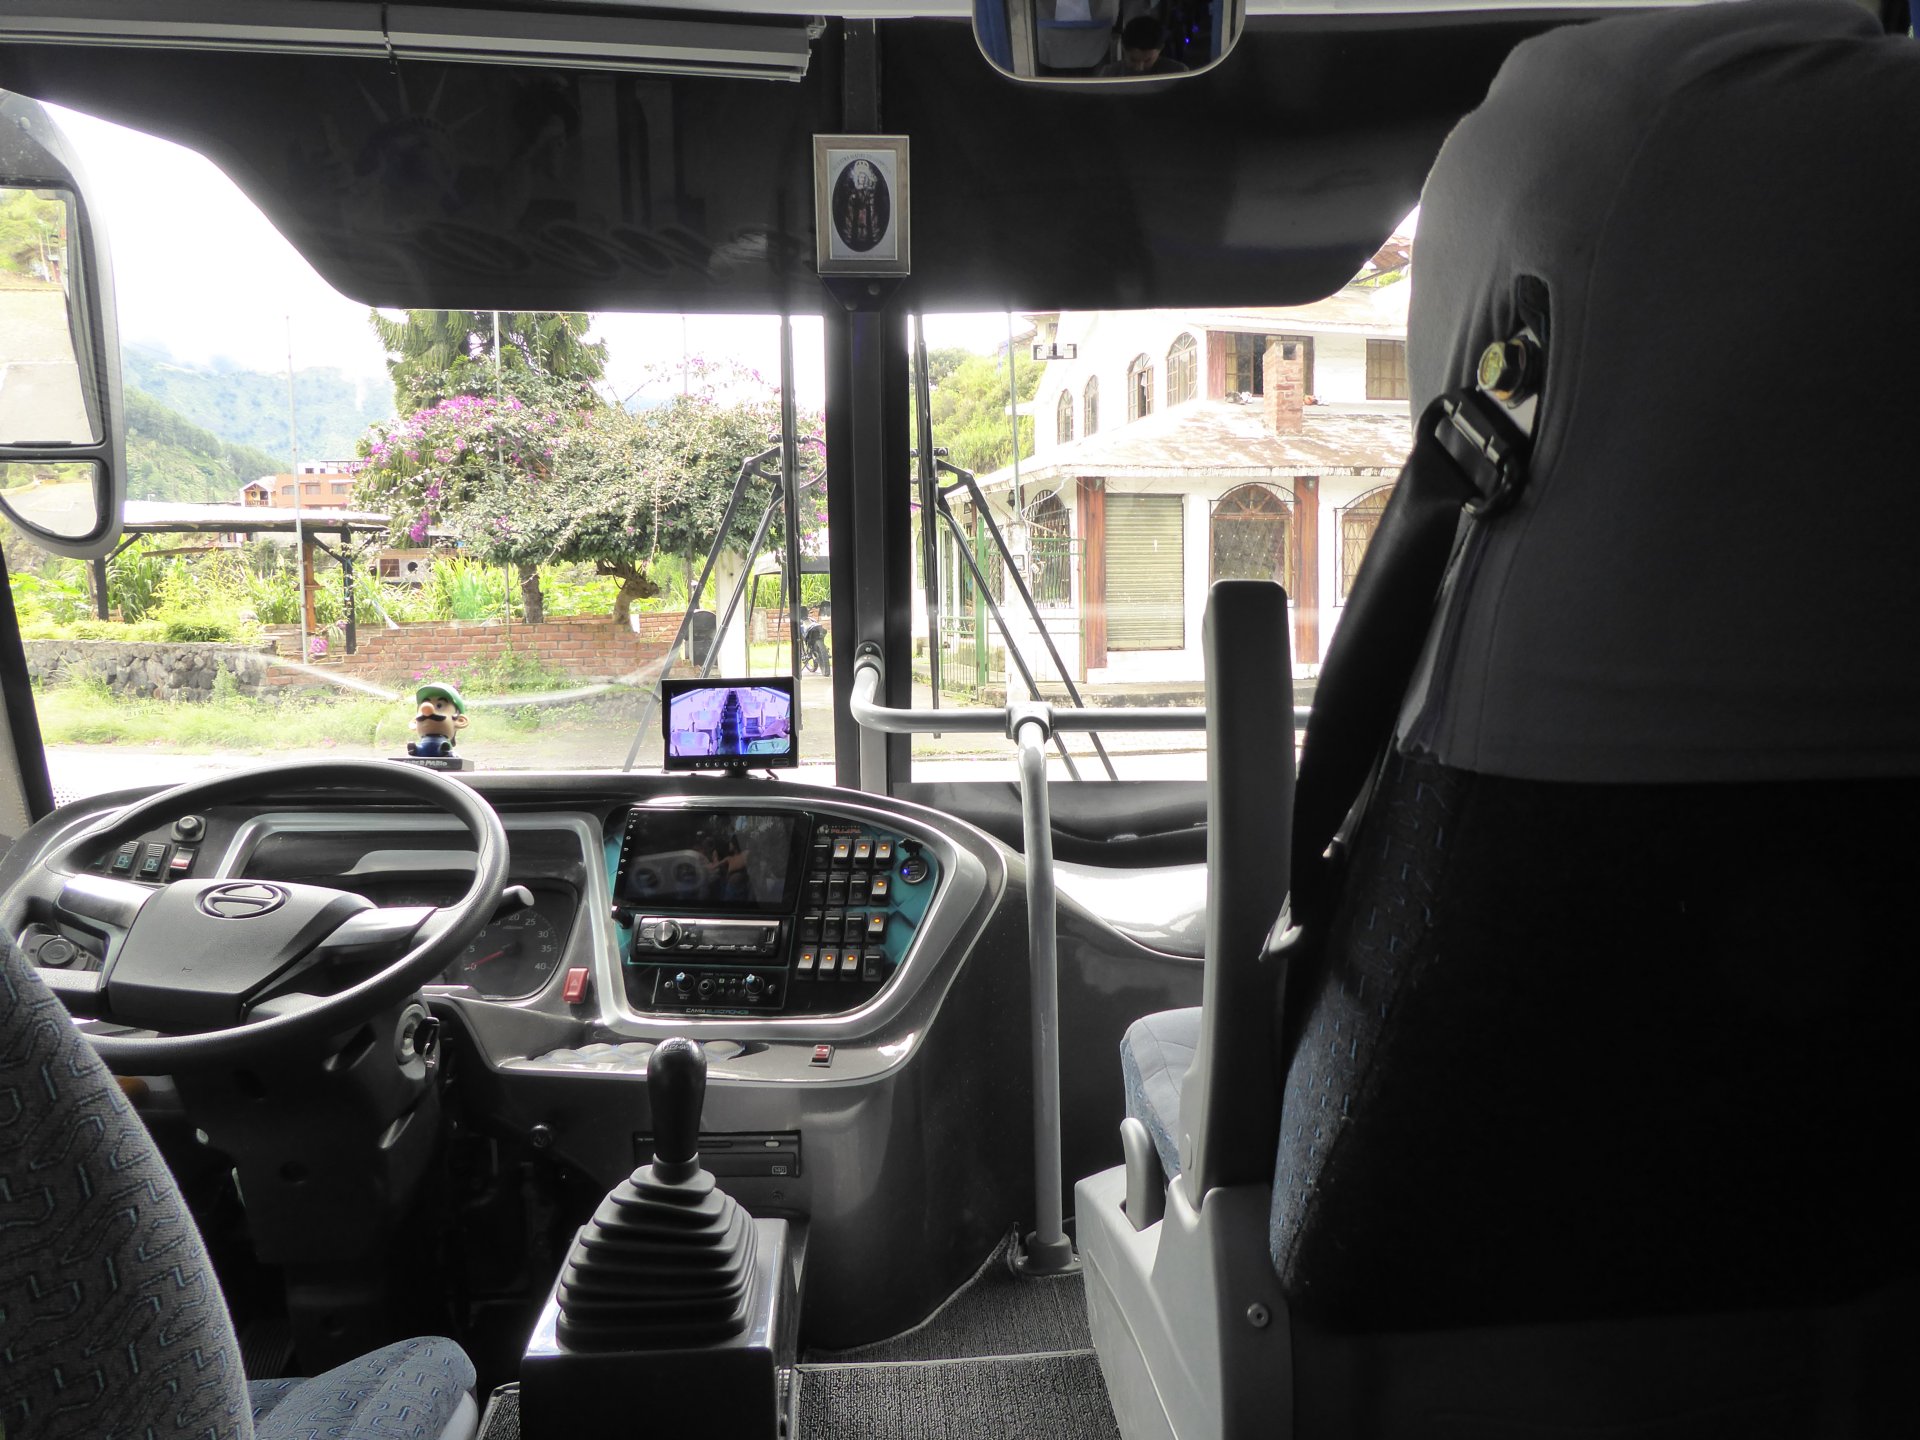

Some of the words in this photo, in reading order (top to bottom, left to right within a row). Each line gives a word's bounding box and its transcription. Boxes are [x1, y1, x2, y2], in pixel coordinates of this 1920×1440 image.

[525, 918, 536, 926] 25
[538, 930, 549, 938] 30
[469, 945, 476, 953] 5
[541, 944, 552, 952] 35
[534, 962, 546, 970] 40
